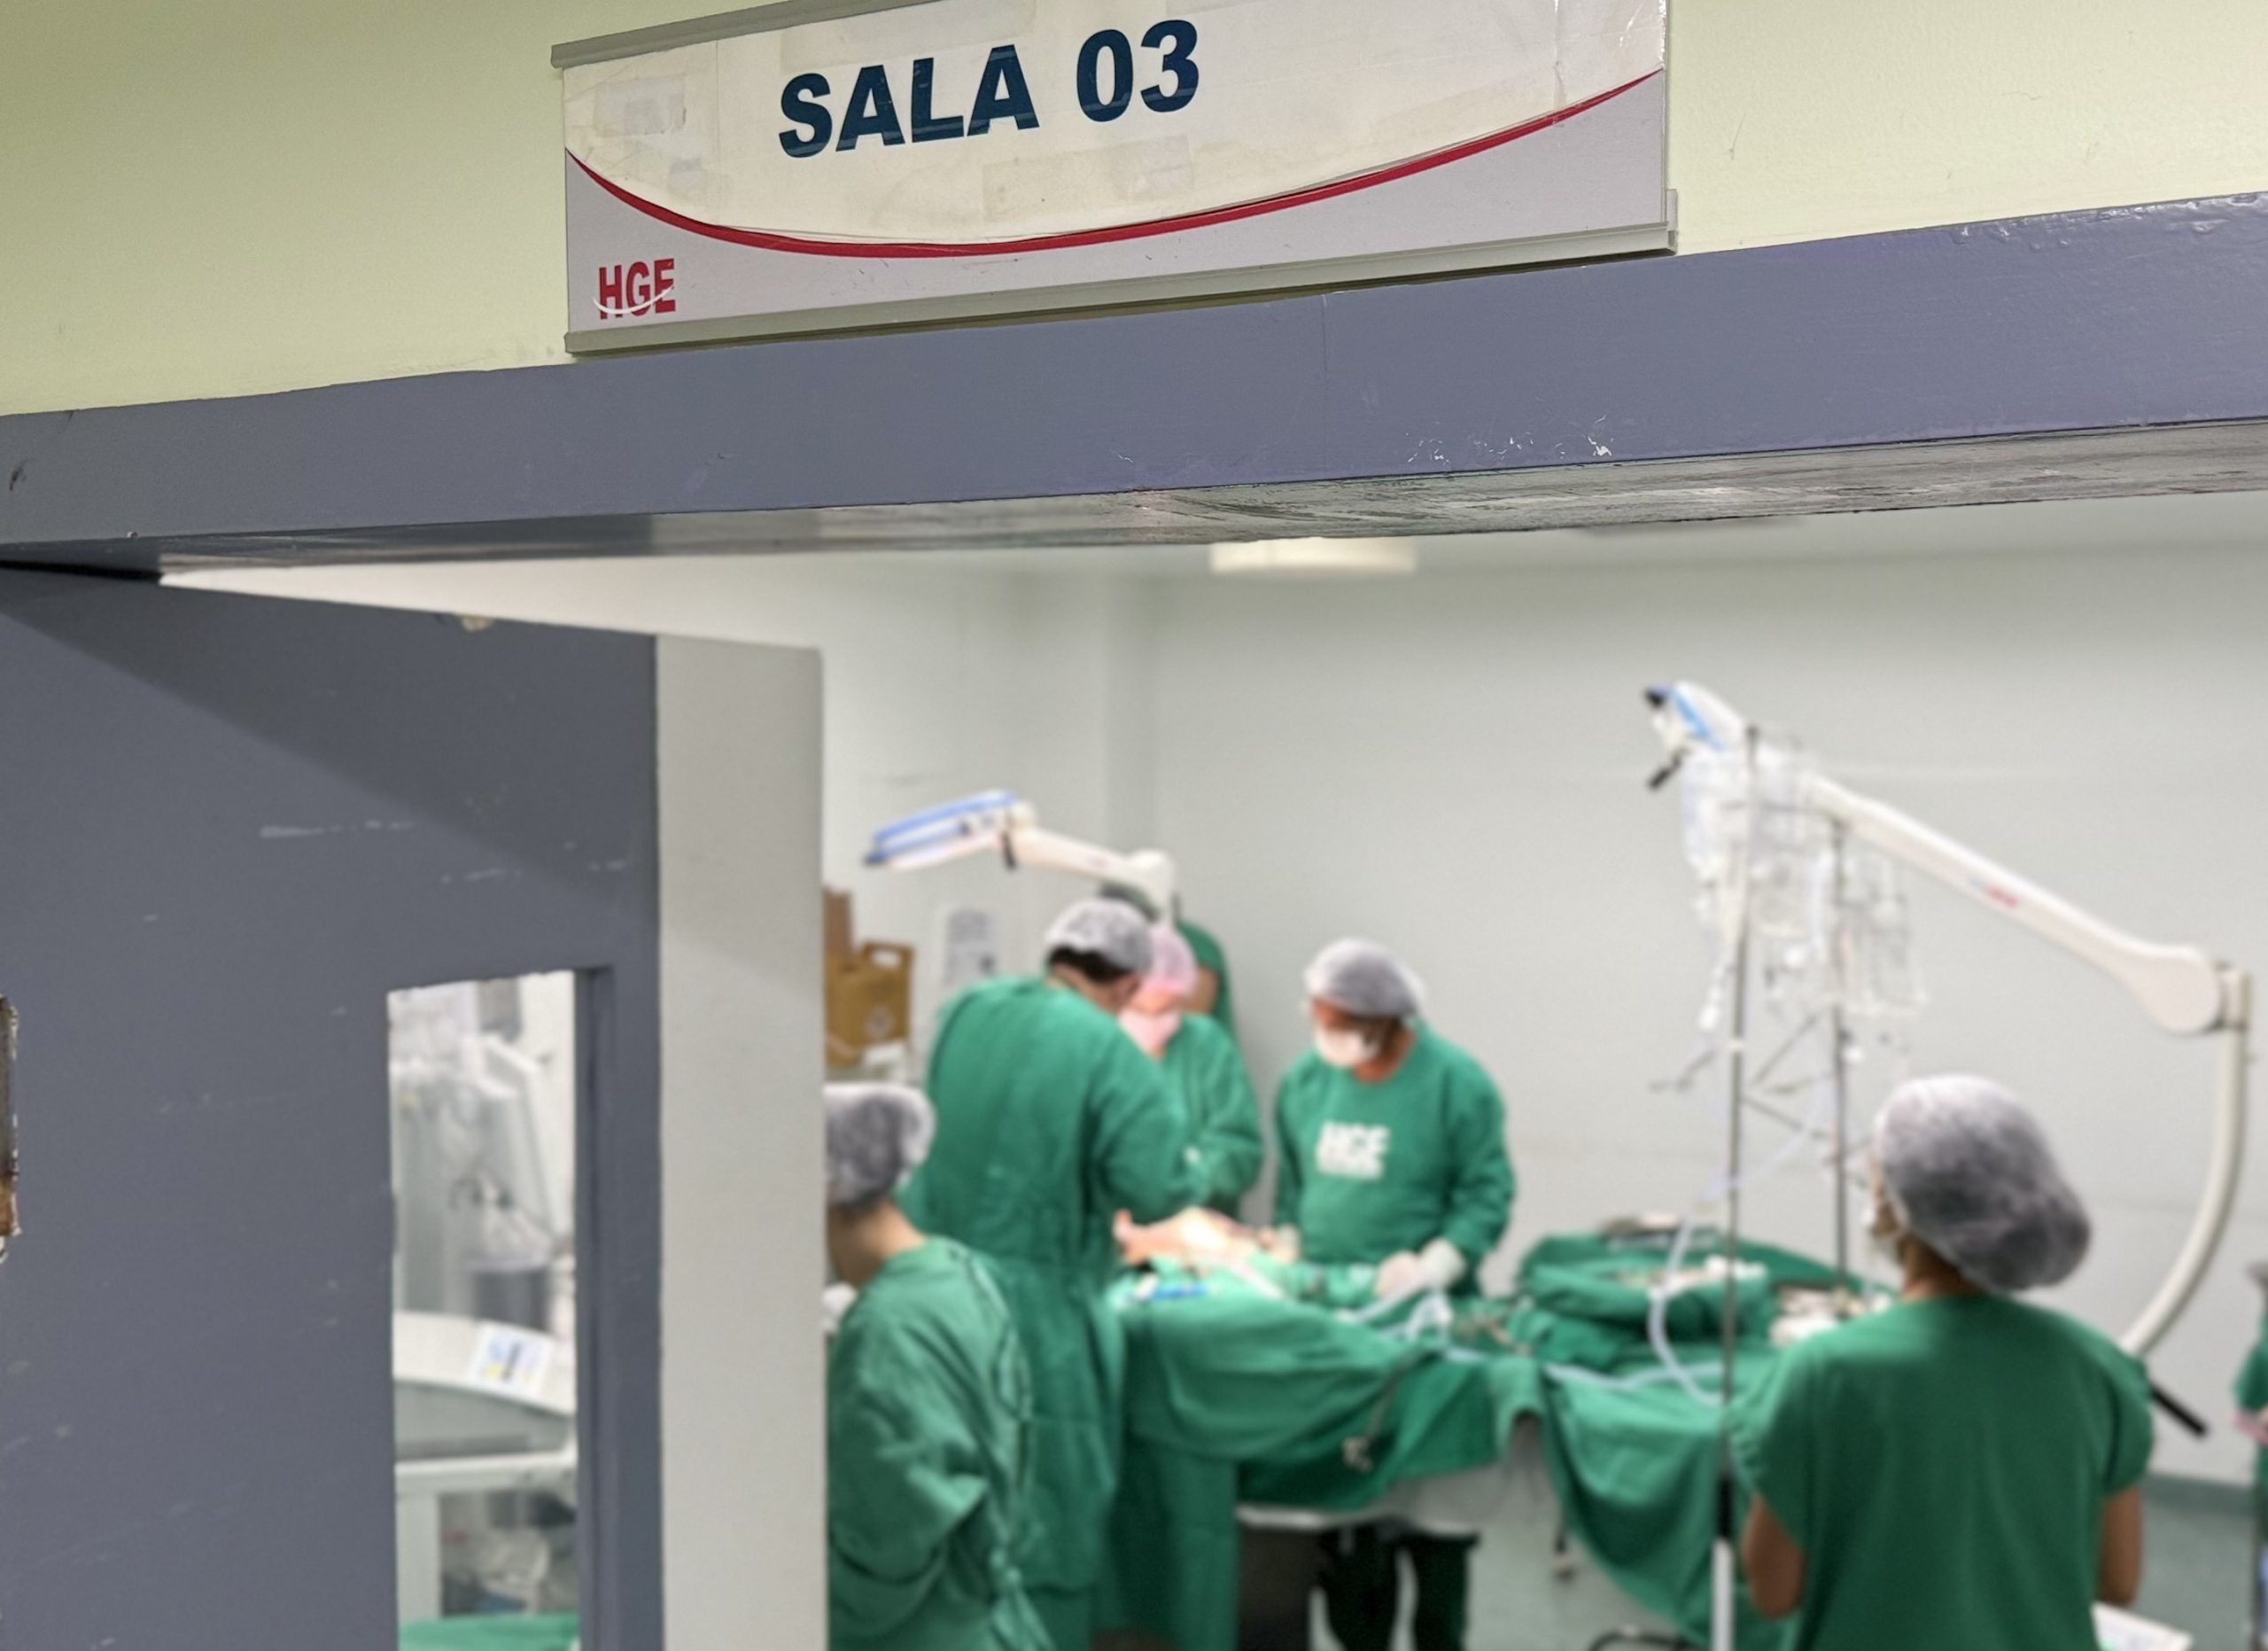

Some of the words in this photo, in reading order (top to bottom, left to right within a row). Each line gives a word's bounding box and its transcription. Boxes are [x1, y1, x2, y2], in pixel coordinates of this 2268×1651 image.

[779, 44, 1040, 159] SALA
[1076, 19, 1200, 122] 03
[598, 258, 676, 320] HGE
